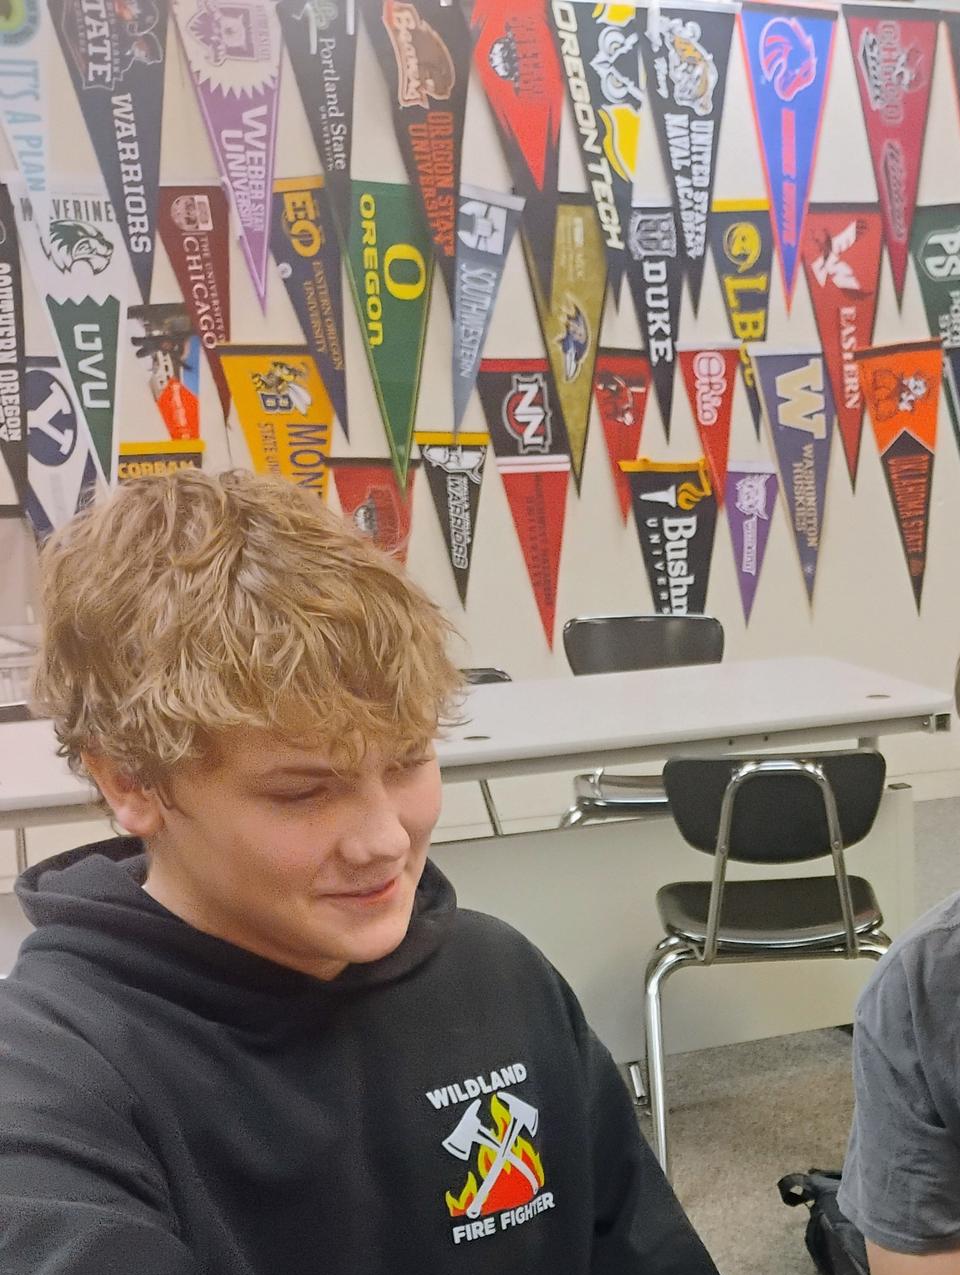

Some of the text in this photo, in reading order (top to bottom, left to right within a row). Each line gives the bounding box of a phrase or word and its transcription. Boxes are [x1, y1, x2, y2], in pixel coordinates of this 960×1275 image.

[3, 111, 41, 125] A
[241, 105, 267, 200] WEBER
[319, 38, 347, 170] Portland State
[428, 111, 454, 188] OREGON
[552, 1, 625, 250] OREGON TECH
[14, 135, 46, 192] PLAN
[111, 93, 151, 253] WARRIORS
[221, 130, 253, 229] UNIVERSITY
[408, 123, 440, 244] UNIVERSITY
[664, 113, 697, 259] NAVAL ACADEMY
[689, 119, 714, 258] UNITED STATES
[183, 236, 217, 349] CHICAGO
[200, 238, 212, 257] THE
[360, 193, 384, 347] OREGON
[383, 243, 427, 301] O
[303, 280, 328, 353] UNIVERSITY
[312, 261, 345, 370] EASTERN OREGON
[459, 263, 497, 378] SOUTHWESTERN
[643, 261, 674, 366] DUKE
[72, 322, 110, 410] UVU
[774, 358, 827, 440] W
[447, 476, 468, 570] WARRIORS
[801, 443, 818, 548] WASHINGTON
[888, 455, 929, 553] OKLAHOMA STATE
[425, 1063, 527, 1109] WILDLAND
[452, 1192, 555, 1245] FIRE FIGHTER
